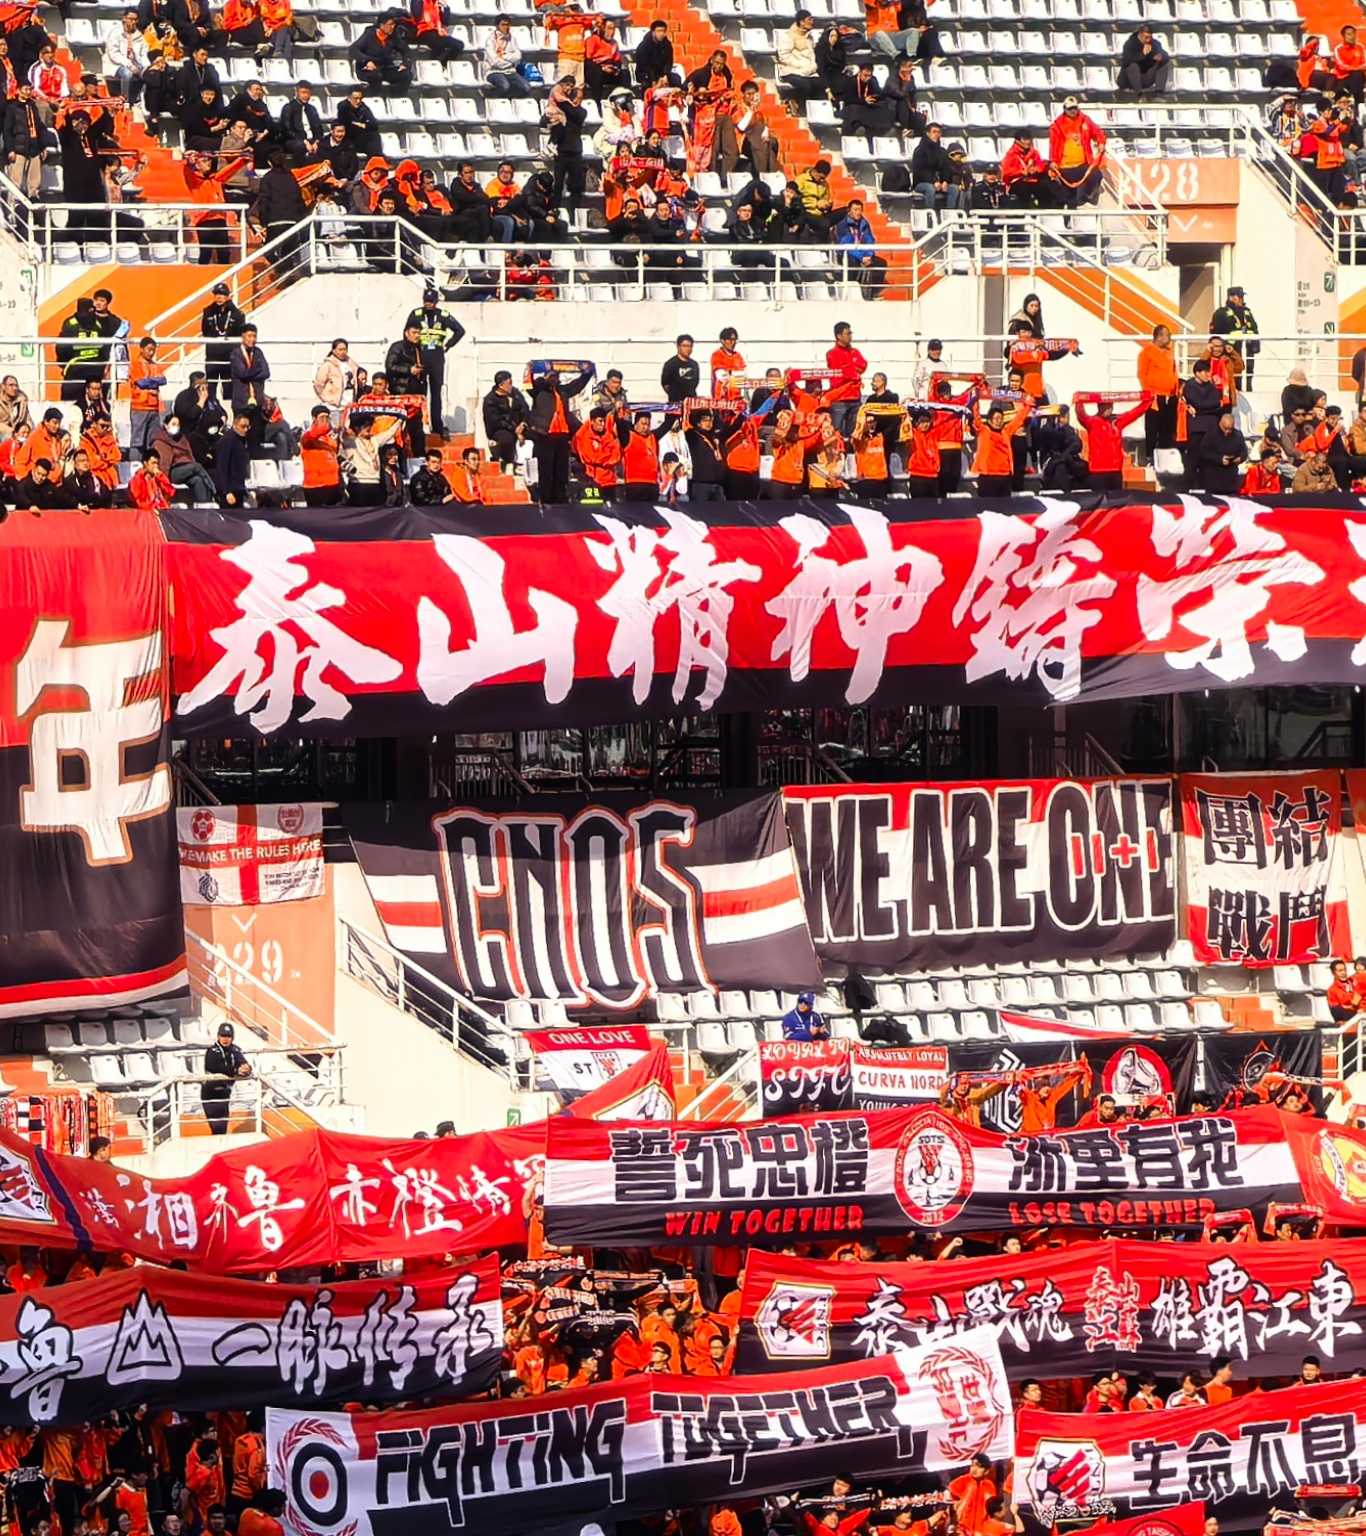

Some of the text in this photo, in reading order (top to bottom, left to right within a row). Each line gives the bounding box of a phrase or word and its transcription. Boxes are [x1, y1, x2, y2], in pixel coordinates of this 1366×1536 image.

[229, 847, 254, 860] THE
[256, 844, 291, 859] RULES
[788, 782, 1176, 943] WE ARE ONE
[548, 1028, 635, 1045] ONE LOVE
[916, 1050, 946, 1063] LOYAL
[857, 1071, 946, 1090] CURVA NORD
[1007, 1116, 1242, 1194] 浙里有我
[665, 1204, 865, 1237] WIN TOGETHER
[1011, 1202, 1075, 1227] LOSE
[377, 1399, 631, 1528] FIGHTING
[1128, 1414, 1361, 1512] 生命不息
